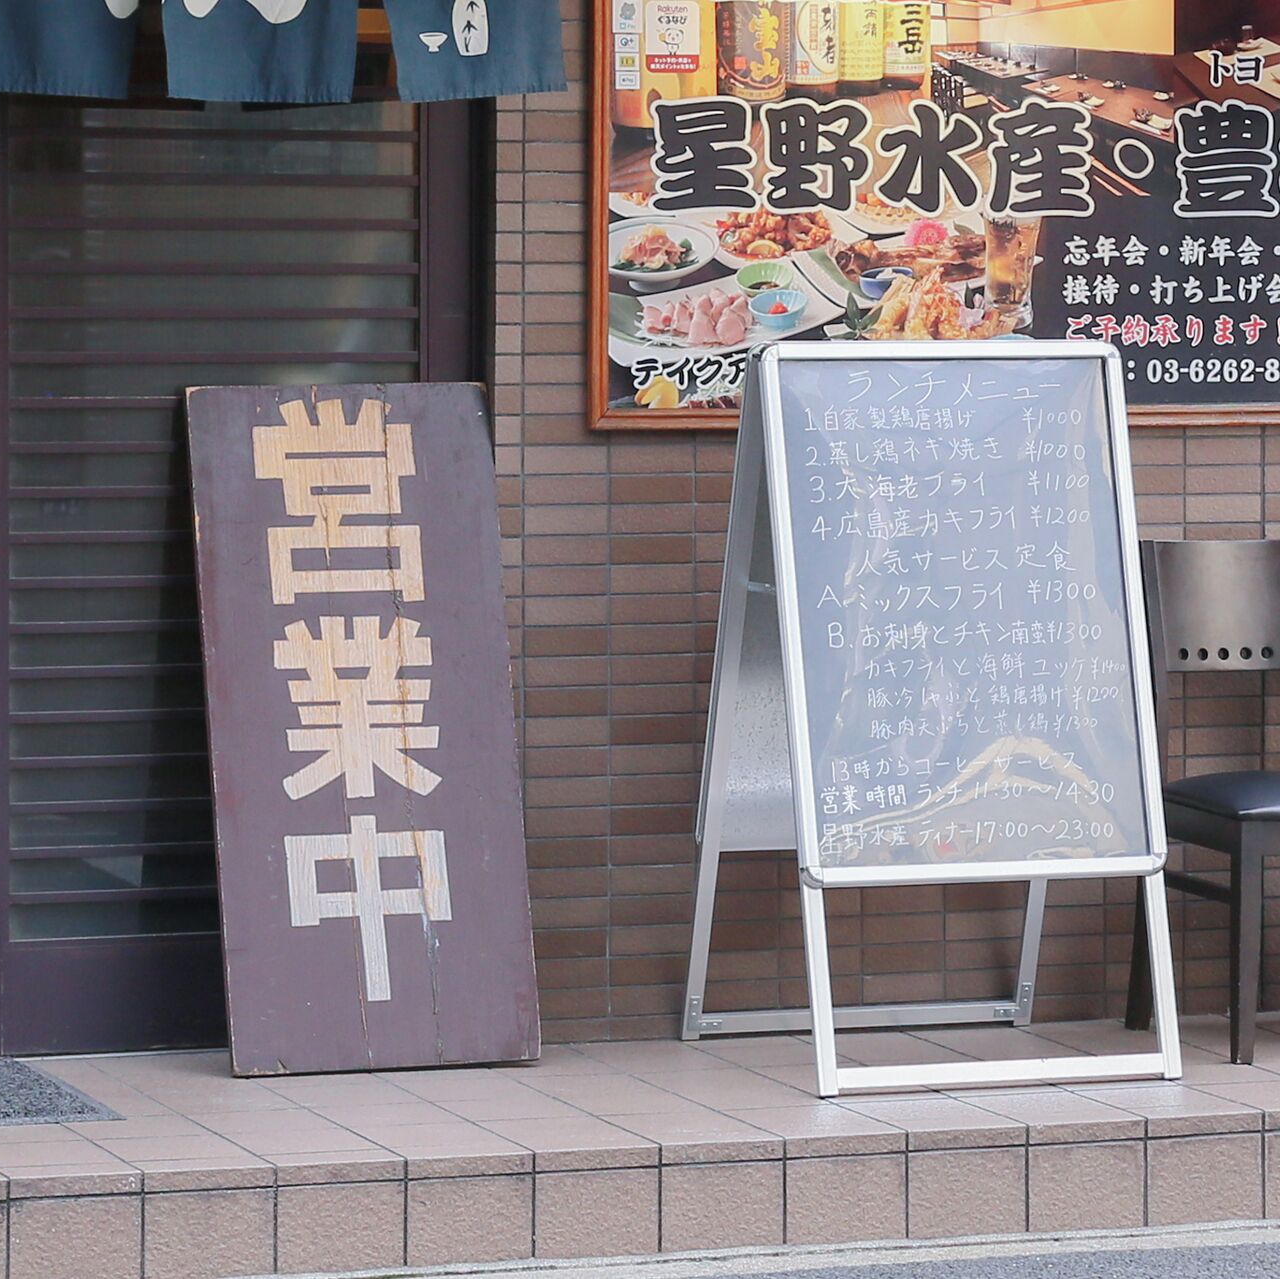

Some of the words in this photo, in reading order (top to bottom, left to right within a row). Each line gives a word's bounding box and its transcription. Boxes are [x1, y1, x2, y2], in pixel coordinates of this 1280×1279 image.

[657, 5, 688, 15] Rakuten
[657, 15, 688, 24] ぐるなび
[897, 3, 925, 55] 三岳
[1207, 51, 1263, 86] トヨ
[847, 370, 1062, 406] ランチメニュー
[1021, 406, 1082, 433] ¥1000
[1024, 437, 1087, 464] ¥1000
[1027, 471, 1091, 497] ¥1100
[1030, 505, 1091, 528] ¥1200
[855, 540, 1078, 577] 人気サービス定食
[1027, 580, 1097, 605] ¥1300
[251, 397, 453, 1002] 営業中
[831, 751, 1084, 783] 13時からコーヒーサービス
[820, 785, 910, 815] 営業時間
[918, 783, 963, 811] ランチ
[820, 823, 911, 856] 星野水産
